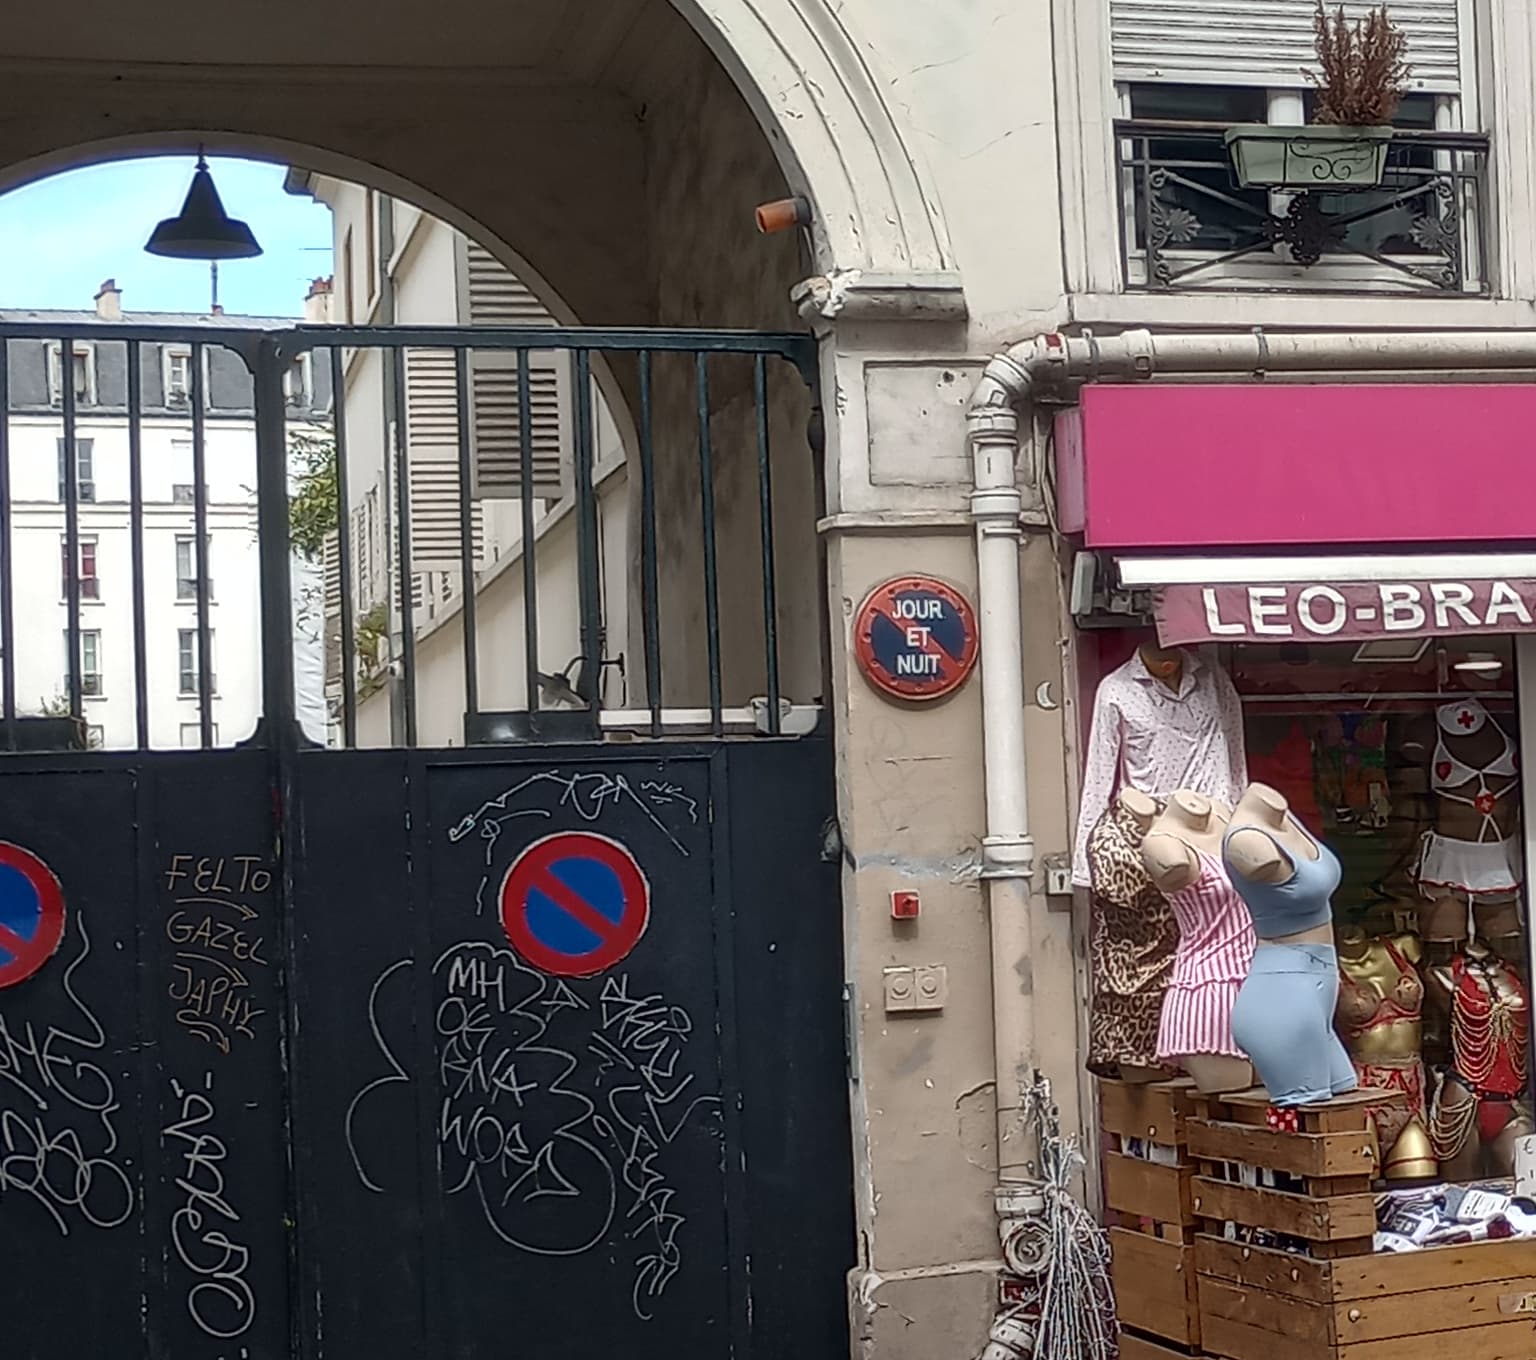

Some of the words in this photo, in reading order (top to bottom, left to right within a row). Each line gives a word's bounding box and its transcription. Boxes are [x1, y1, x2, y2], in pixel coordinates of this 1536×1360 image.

[892, 600, 943, 619] JOUR
[1202, 581, 1533, 635] LEO-BRA
[906, 627, 931, 647] ET
[897, 654, 941, 674] NUIT
